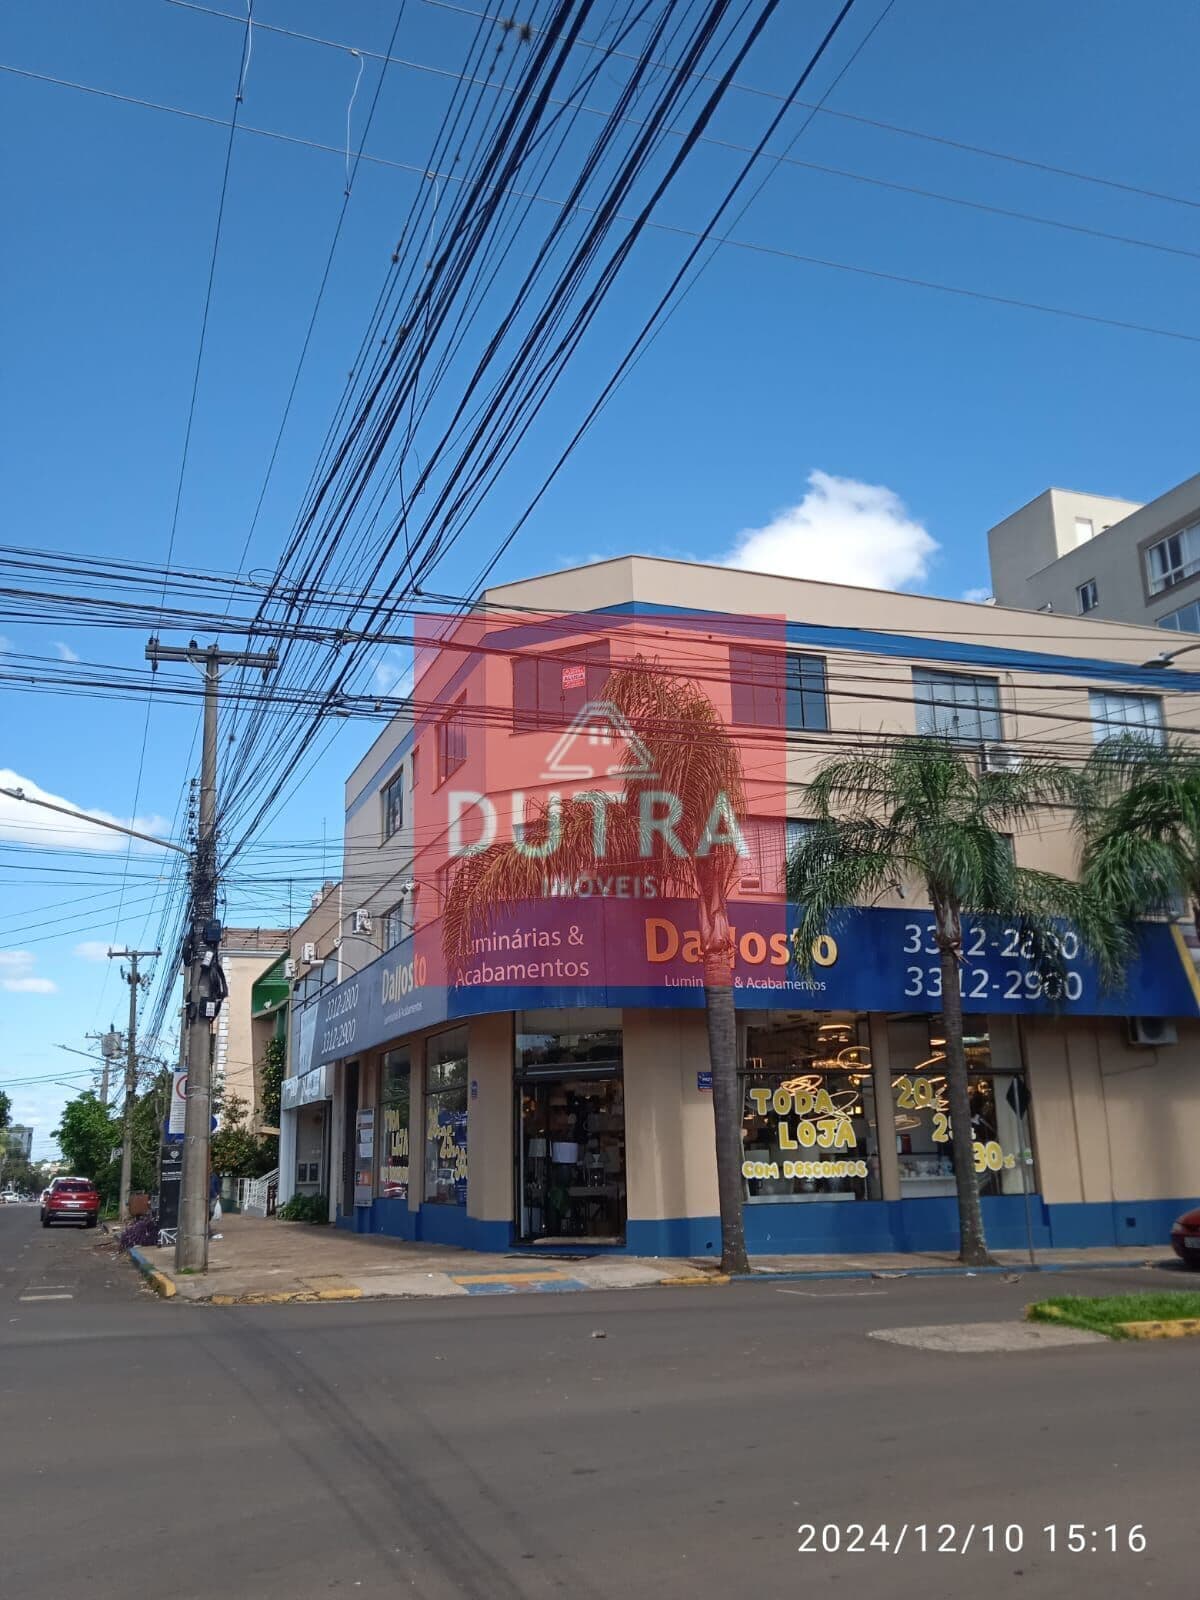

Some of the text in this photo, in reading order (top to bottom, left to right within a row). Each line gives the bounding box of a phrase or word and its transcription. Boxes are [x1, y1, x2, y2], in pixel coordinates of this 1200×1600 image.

[568, 925, 584, 946] &
[455, 958, 590, 989] Acabamentos
[746, 977, 826, 991] Acabamentos
[750, 1088, 834, 1116] TODA
[779, 1120, 857, 1150] LOJA
[742, 1161, 779, 1179] COM
